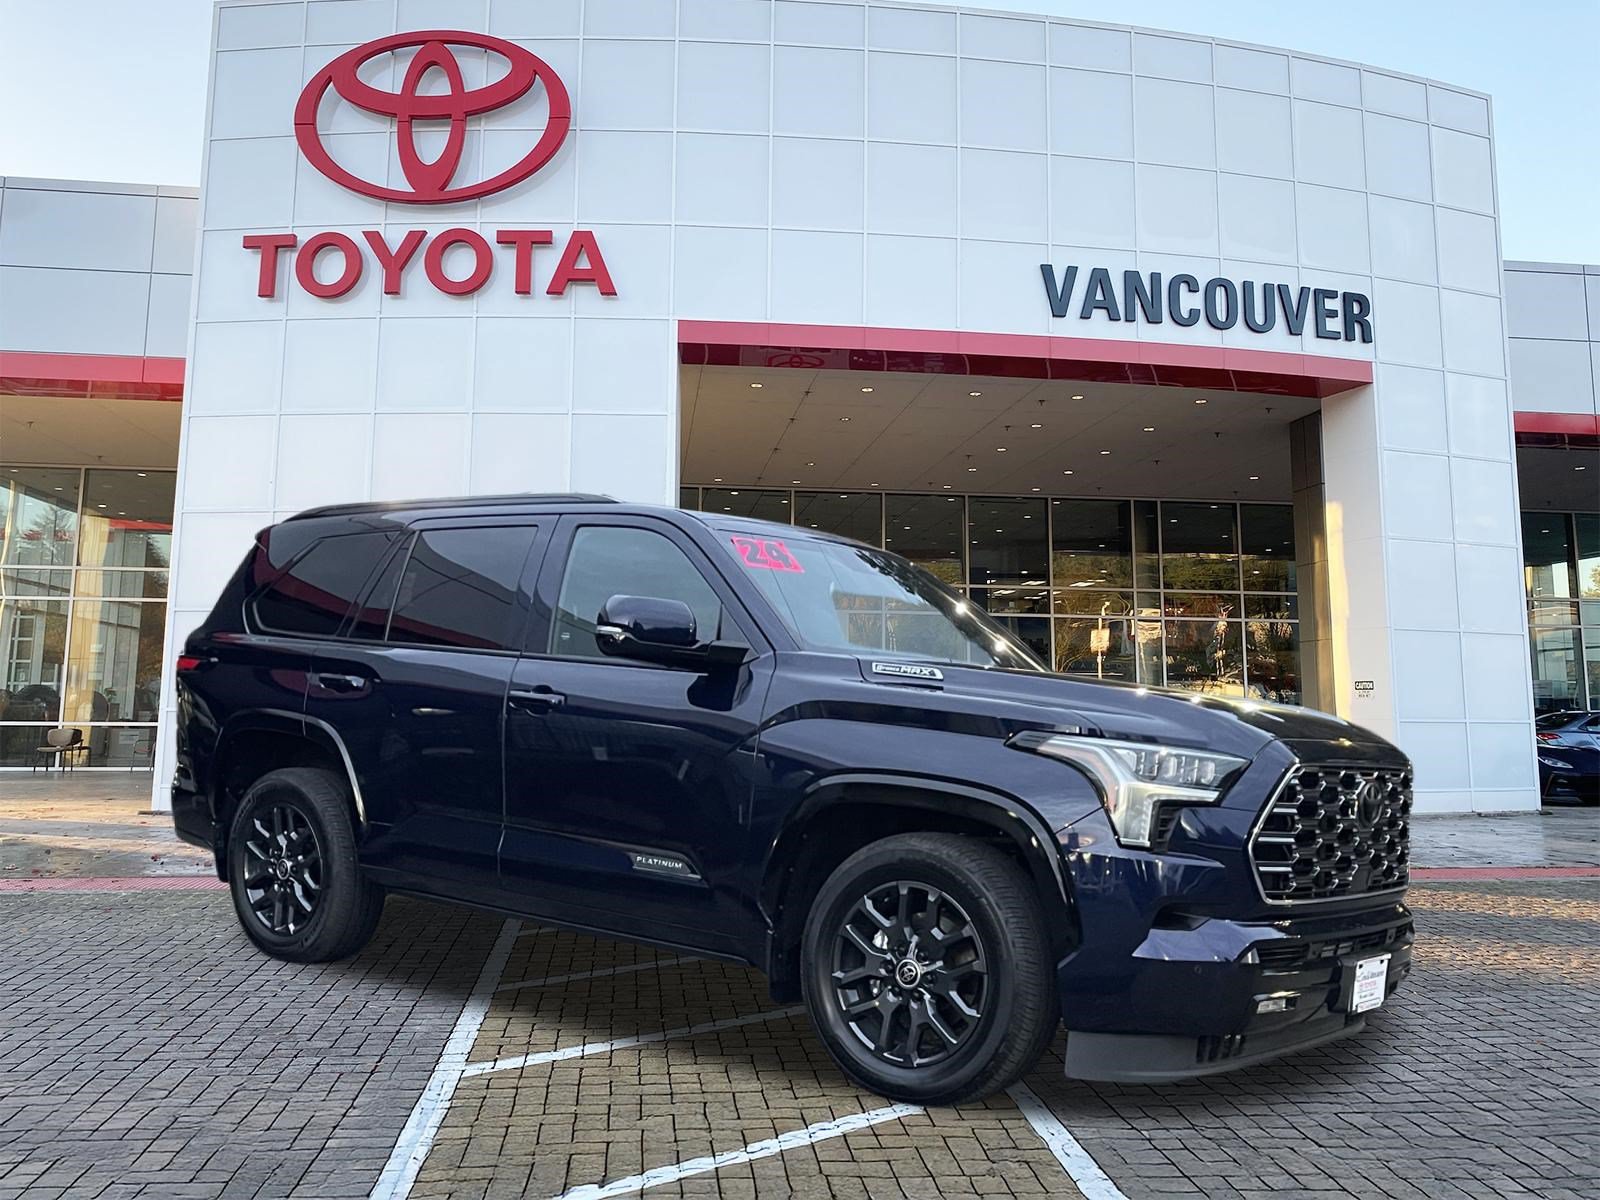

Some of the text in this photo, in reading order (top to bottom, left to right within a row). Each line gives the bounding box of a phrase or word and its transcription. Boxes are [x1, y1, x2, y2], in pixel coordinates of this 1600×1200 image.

[243, 228, 618, 299] TOYOTA
[1040, 264, 1373, 343] VANCOUVER
[636, 856, 683, 869] PLATINUM
